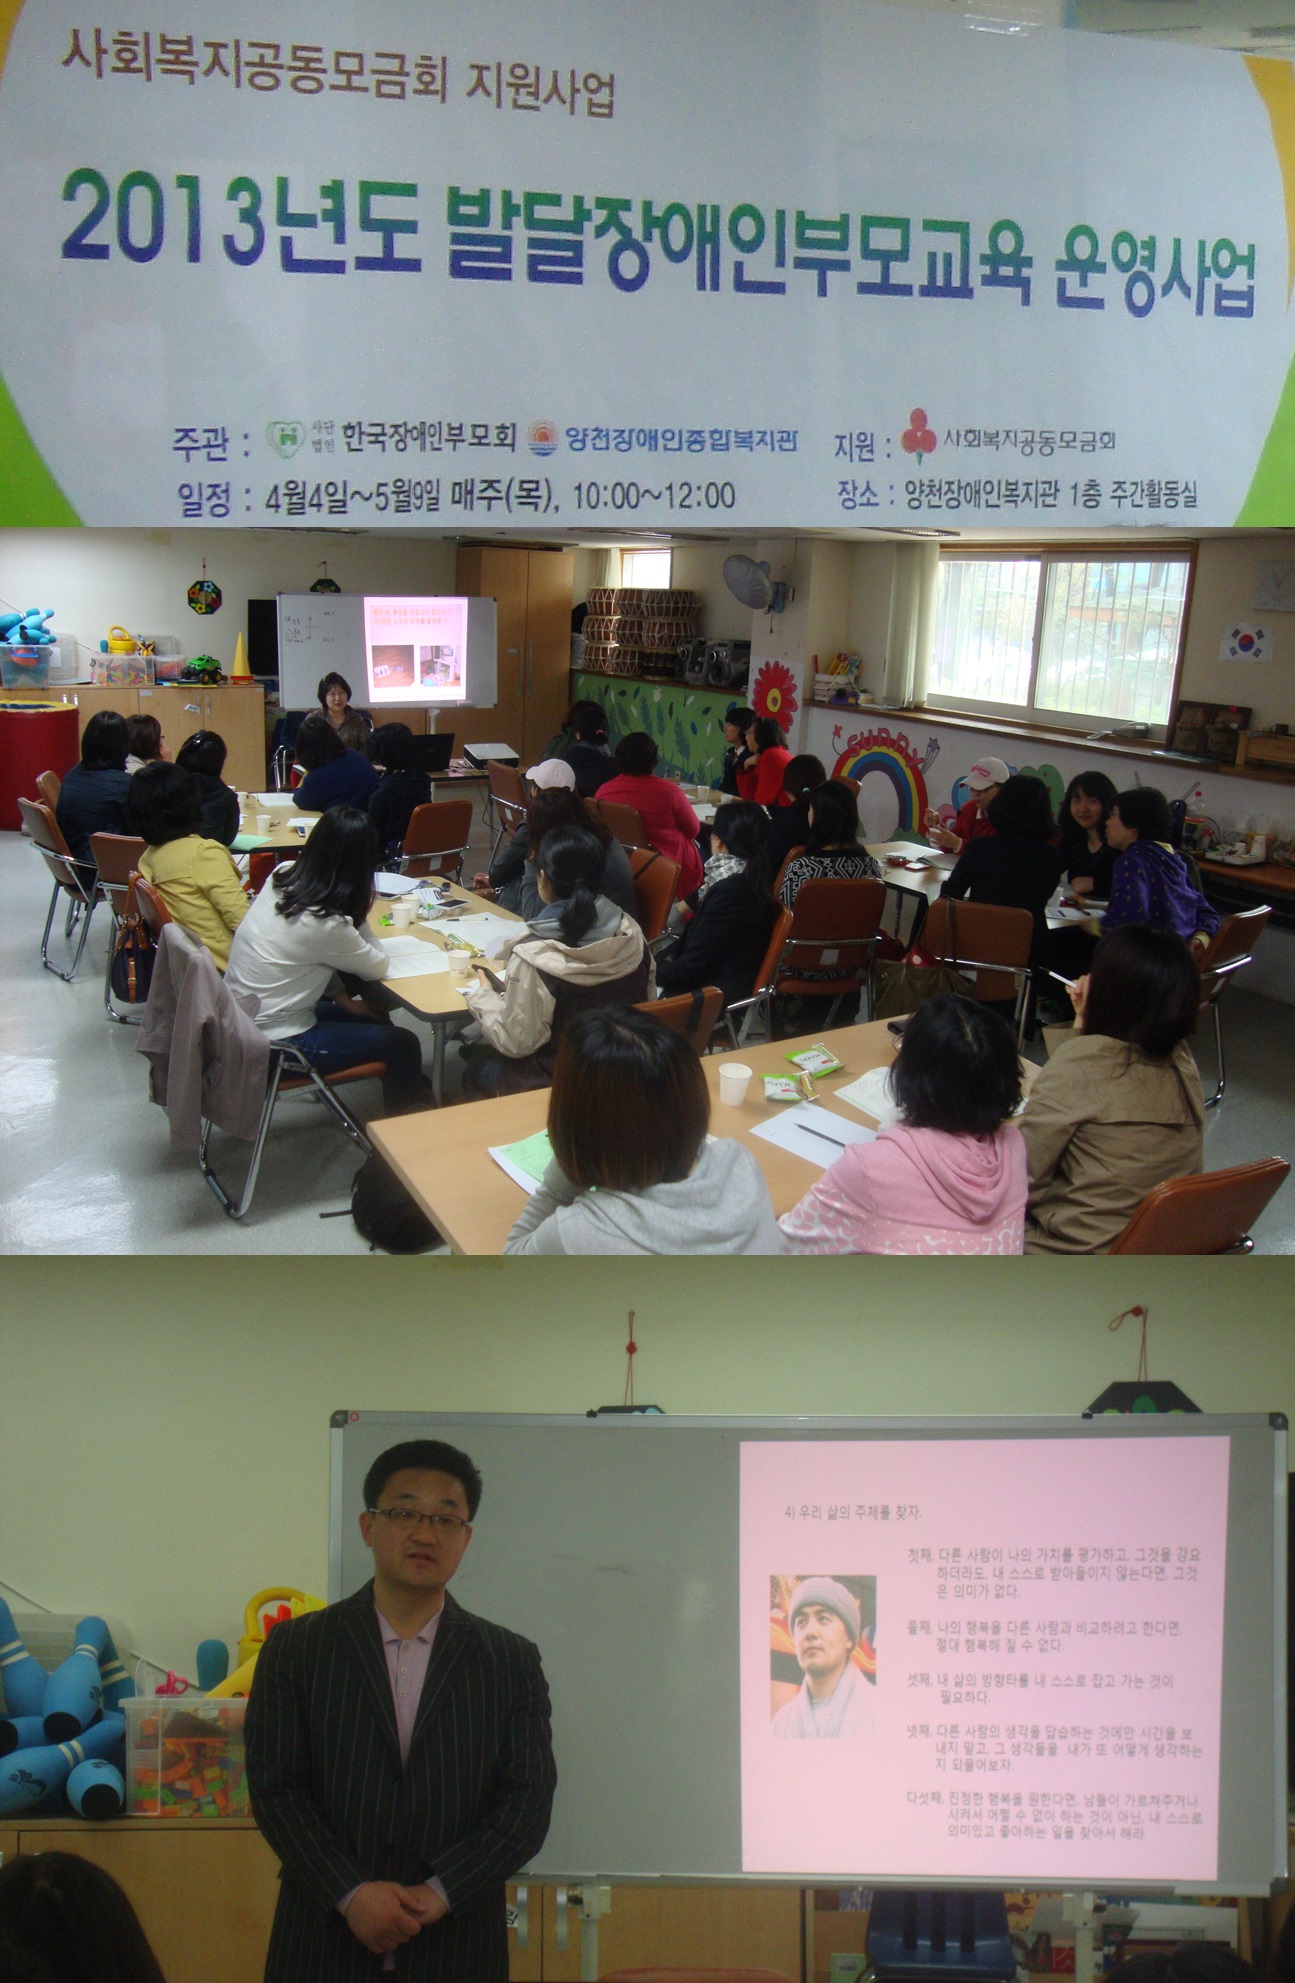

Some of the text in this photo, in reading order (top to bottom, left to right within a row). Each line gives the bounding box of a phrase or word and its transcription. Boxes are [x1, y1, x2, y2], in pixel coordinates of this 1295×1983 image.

[62, 27, 617, 119] 사회복지공동모금회 지원사업
[61, 167, 1256, 320] 2013년도 발달장애인부모교육 운영사업
[172, 427, 229, 462] 주관
[342, 421, 517, 453] 한국장애인부모회
[565, 426, 800, 453] 양천장애인종합복지관
[834, 431, 876, 463] 지원
[943, 428, 1117, 456] 사회복지공동모금회
[178, 482, 231, 518] 일정
[573, 481, 735, 510] 10:00~12:00
[838, 479, 880, 510] 장소
[904, 479, 1060, 511] 양천장애인복지관
[1070, 480, 1101, 509] 1층
[1109, 479, 1198, 510] 주간활동실
[799, 1504, 822, 1520] 우리
[828, 1504, 850, 1520] 삶의
[855, 1504, 891, 1520] 주체를
[936, 1583, 1020, 1599] 은 의미가 없다.
